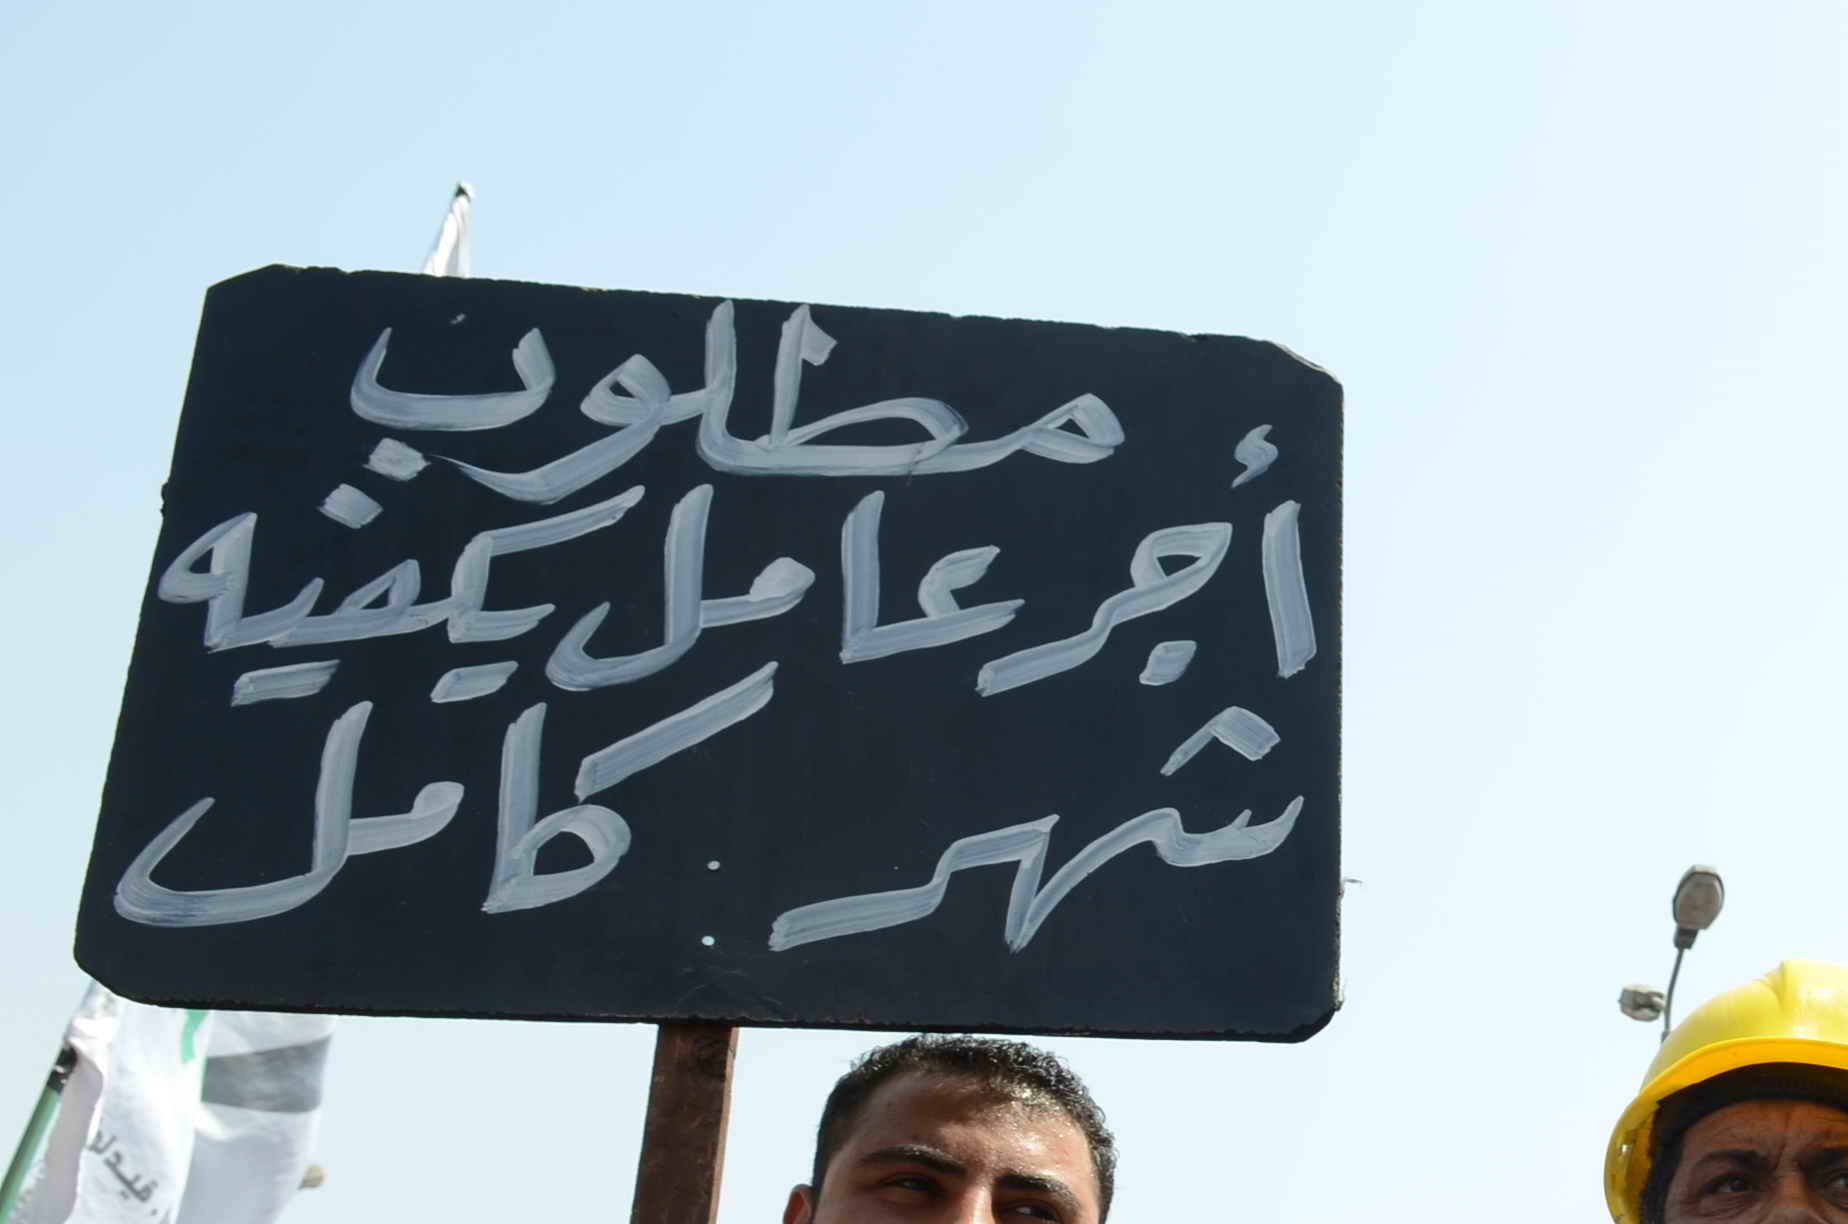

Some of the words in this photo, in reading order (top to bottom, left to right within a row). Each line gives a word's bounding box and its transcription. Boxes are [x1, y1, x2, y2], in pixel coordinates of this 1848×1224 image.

[350, 300, 1124, 505] مطلوب
[157, 484, 646, 706] يكفيه
[545, 484, 1023, 691] عامل
[976, 424, 1316, 697] أجر
[113, 661, 778, 928] كامل
[769, 705, 1304, 952] شهر
